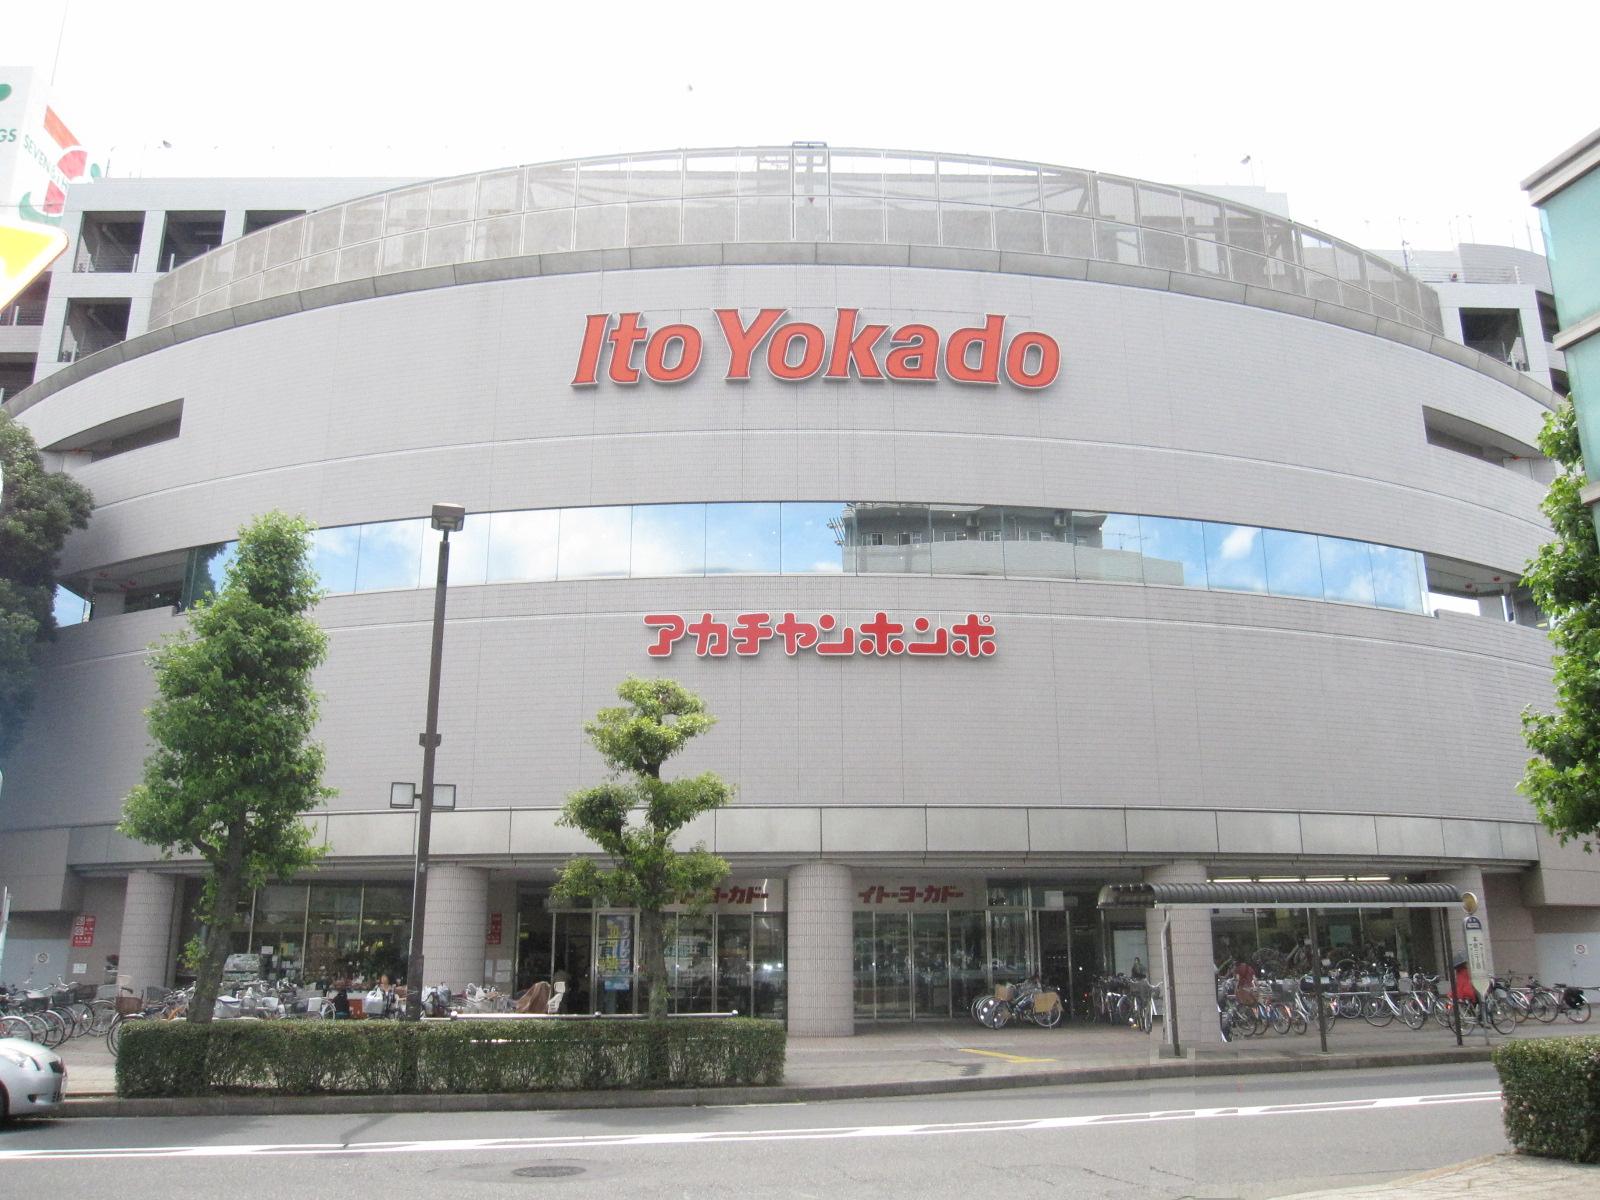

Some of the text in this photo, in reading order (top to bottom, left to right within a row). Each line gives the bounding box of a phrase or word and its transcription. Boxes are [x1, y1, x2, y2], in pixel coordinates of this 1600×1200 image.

[858, 885, 964, 904] イトーヨーカドー
